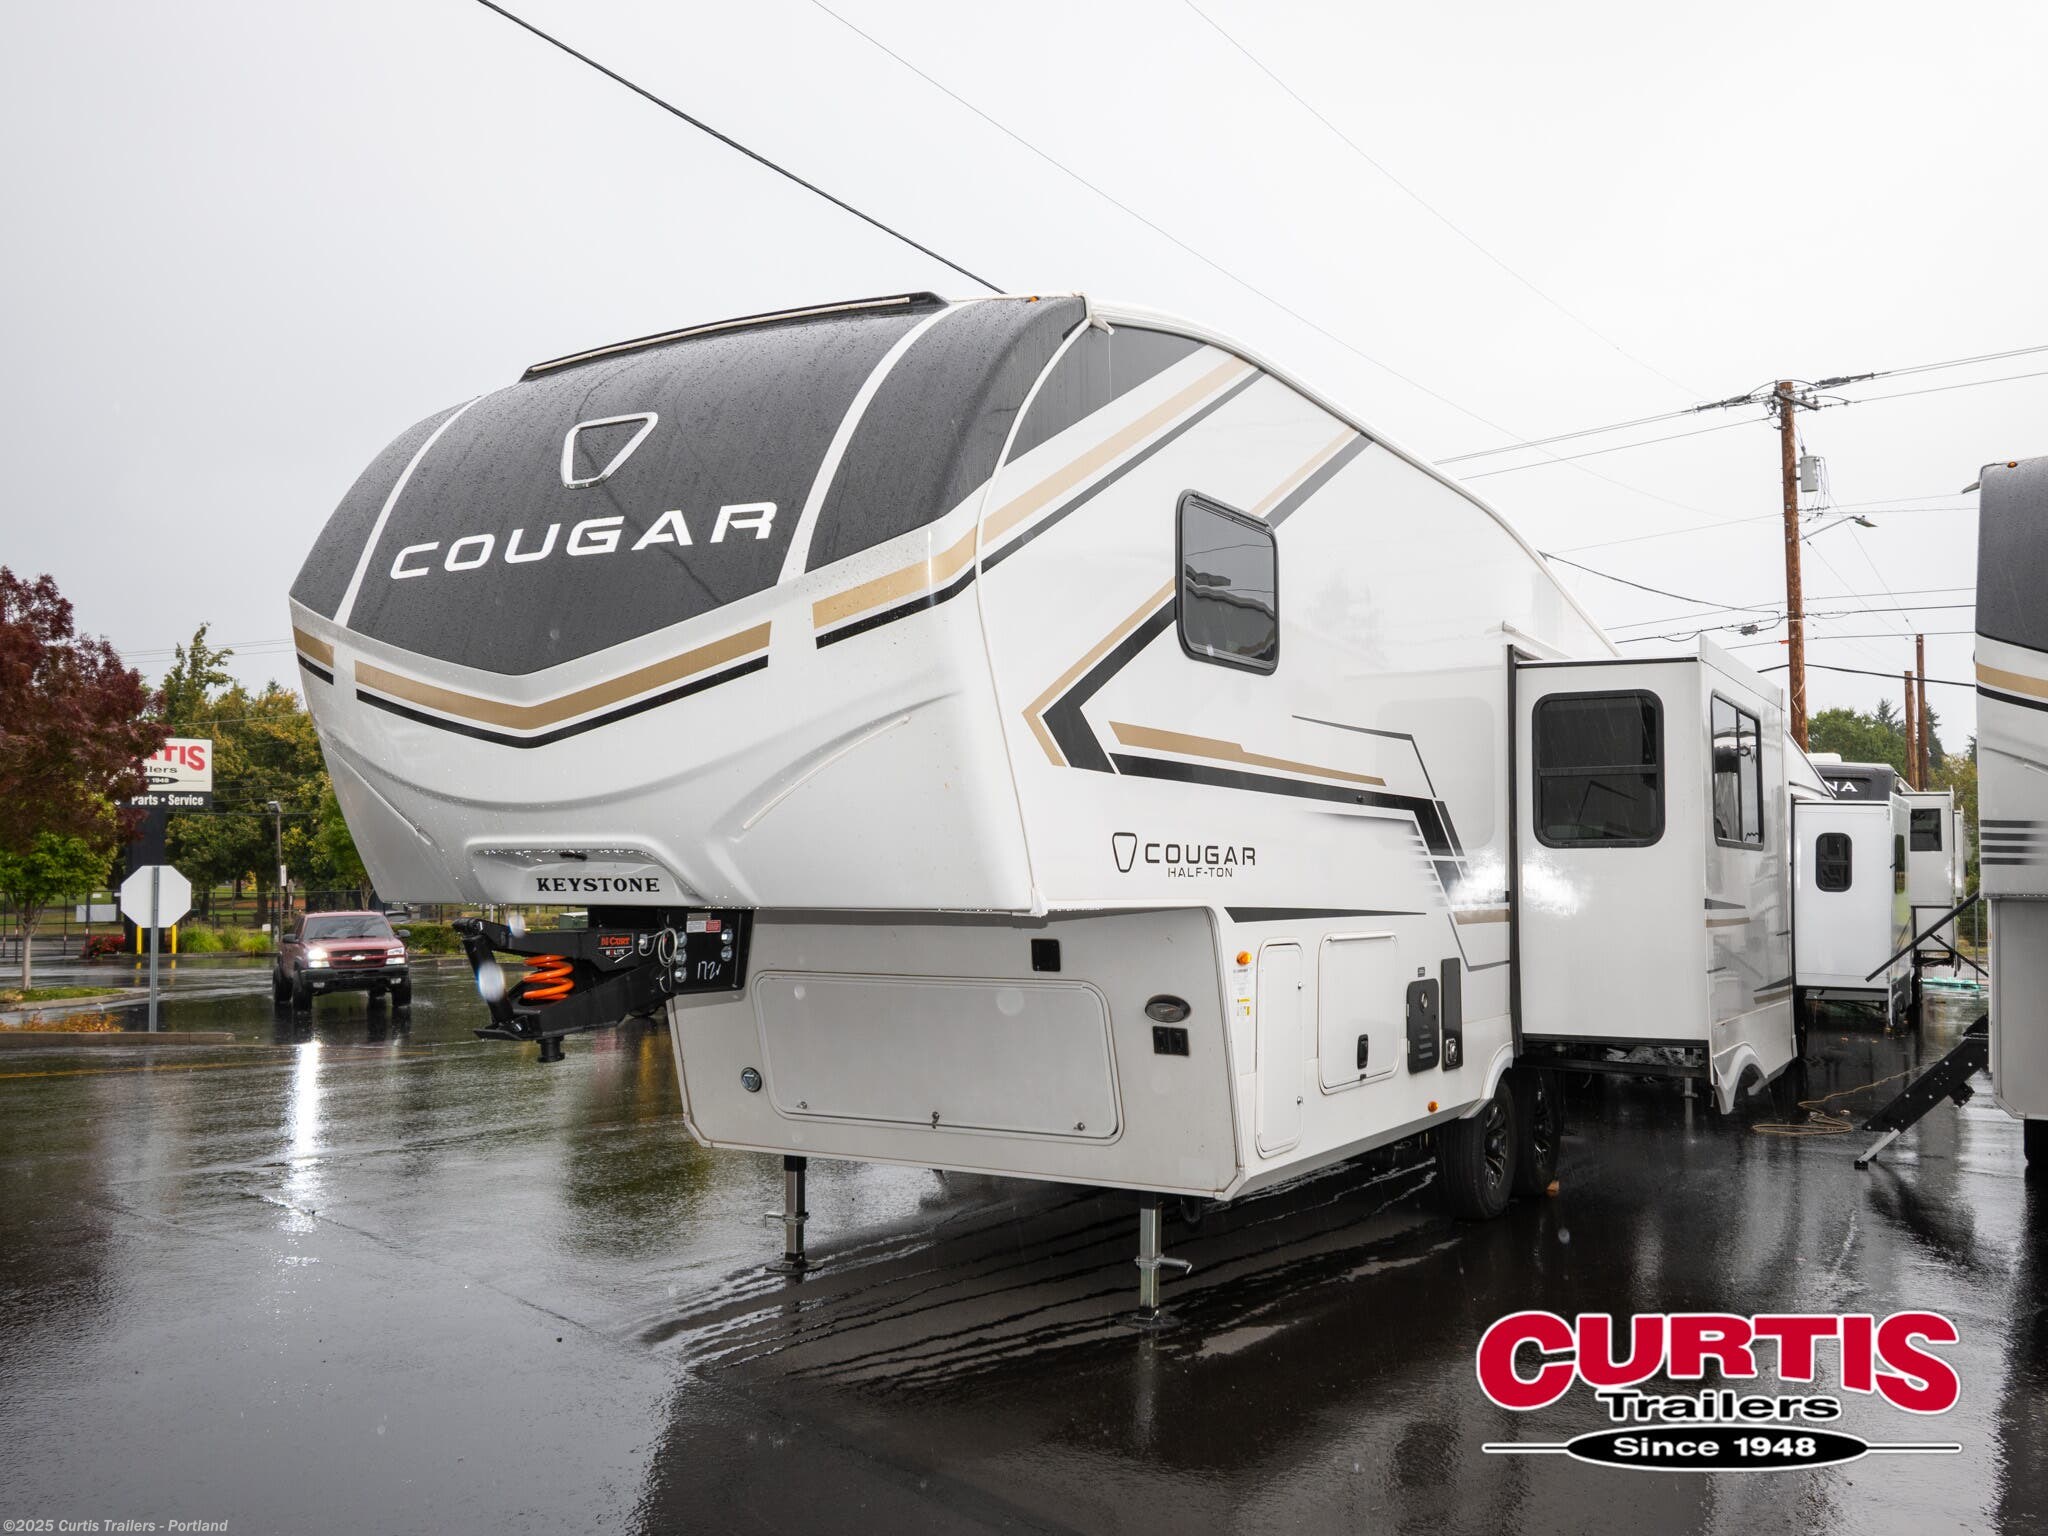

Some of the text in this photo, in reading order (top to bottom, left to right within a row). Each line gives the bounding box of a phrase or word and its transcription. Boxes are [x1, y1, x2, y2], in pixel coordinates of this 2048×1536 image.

[390, 501, 777, 579] COUGAR
[147, 745, 205, 771] TIS
[1824, 781, 1858, 792] NA
[131, 794, 204, 806] Parts Service
[1145, 843, 1256, 866] COUGAR
[1167, 867, 1233, 878] HALF-TON
[536, 877, 660, 892] KEYSTONE
